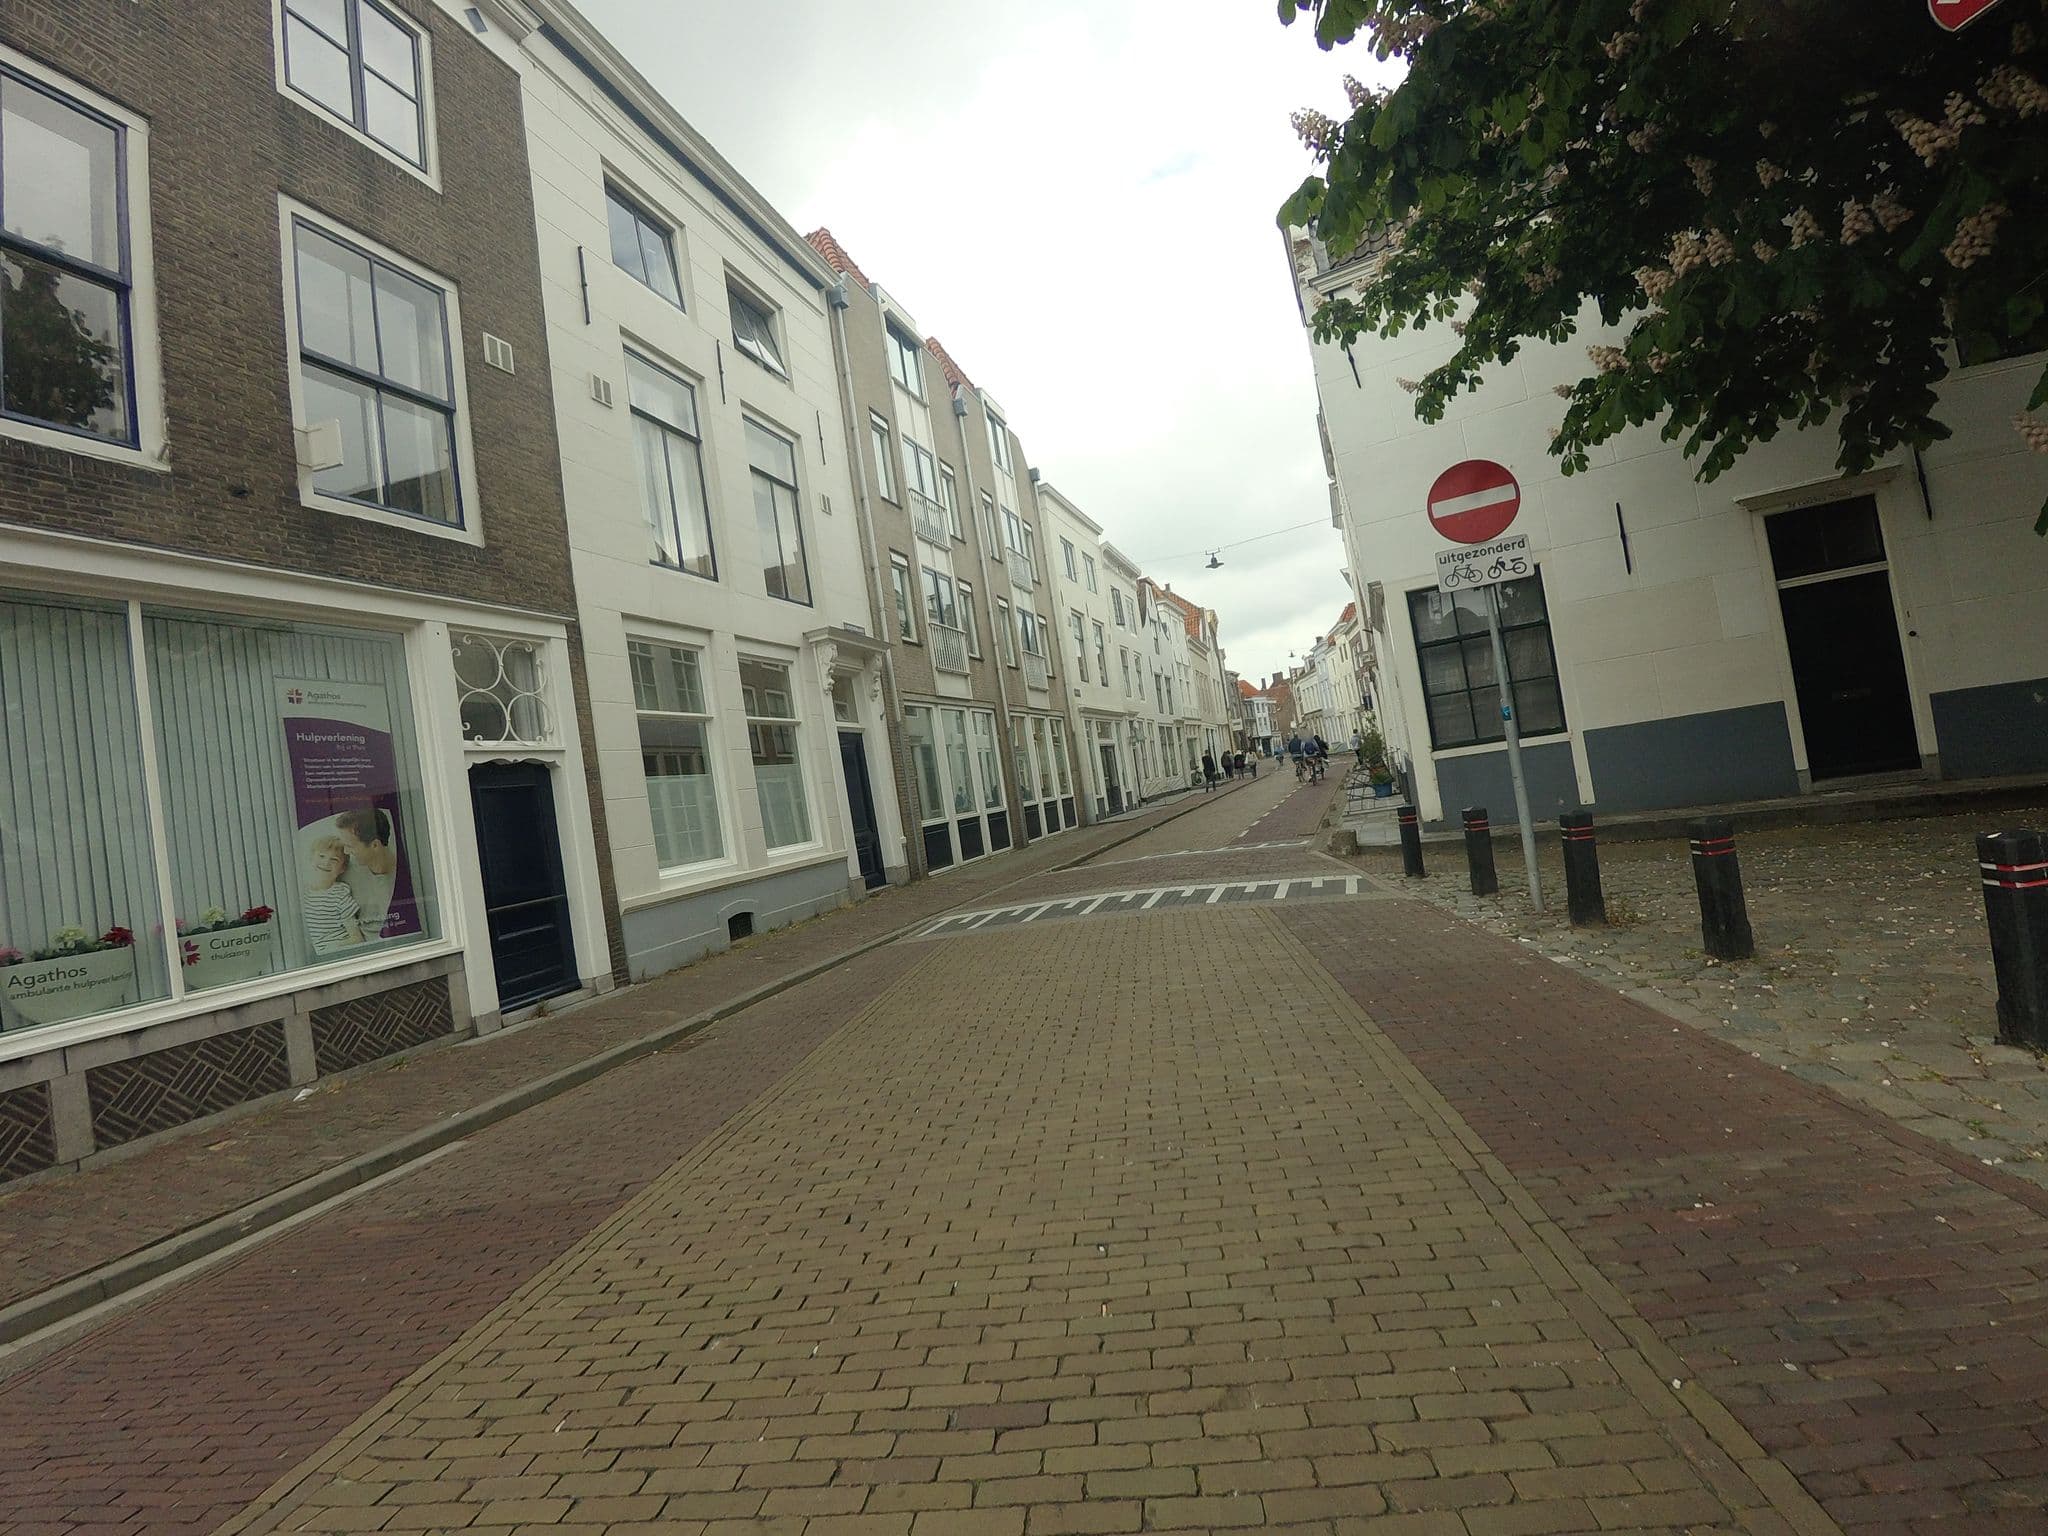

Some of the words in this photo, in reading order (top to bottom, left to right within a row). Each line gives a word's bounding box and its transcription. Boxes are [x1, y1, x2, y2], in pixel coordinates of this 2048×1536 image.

[1439, 538, 1526, 565] uitgezonderd
[296, 732, 366, 744] Hulpverlening
[7, 967, 88, 989] Agathos
[9, 984, 71, 1000] ambulante
